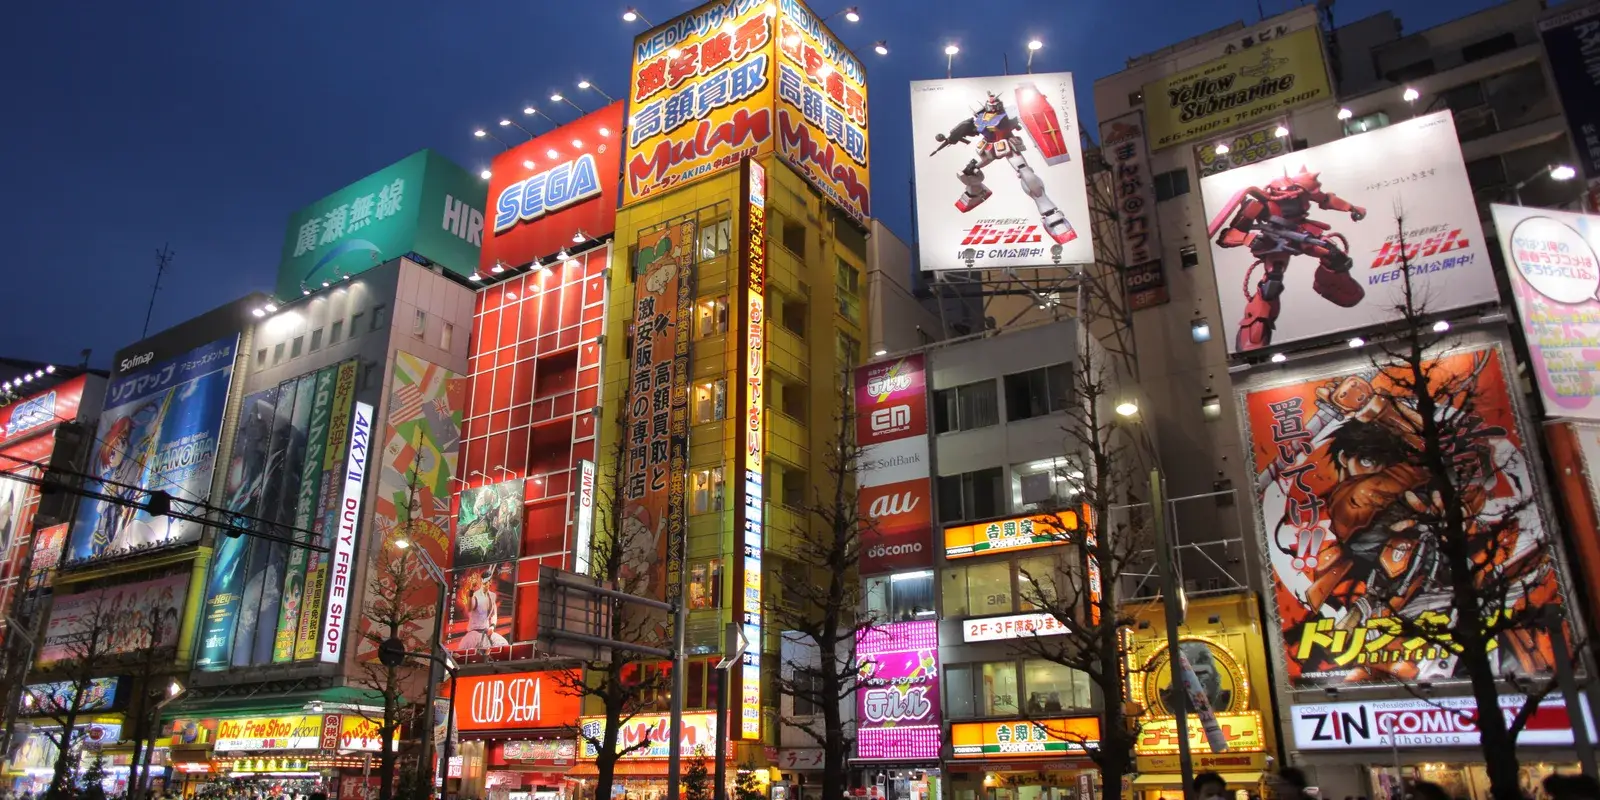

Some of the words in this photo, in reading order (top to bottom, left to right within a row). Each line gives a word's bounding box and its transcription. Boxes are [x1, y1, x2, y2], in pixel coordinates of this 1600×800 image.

[637, 0, 766, 63] MEDIAリサイク
[635, 13, 769, 103] 激安販売
[1203, 63, 1229, 76] BASE
[630, 55, 768, 147] 高額買取
[1168, 72, 1237, 108] Yellow
[1179, 74, 1295, 124] Submarine
[780, 63, 867, 168] 高額買取
[628, 107, 772, 197] Mulan
[777, 109, 870, 218] Mulan
[494, 153, 603, 232] SEGA
[640, 174, 681, 196] ムーラン
[681, 163, 712, 181] AKIBA
[817, 178, 838, 201] AKIBA
[442, 194, 485, 248] HIR
[961, 224, 1042, 246] ガンダム
[957, 247, 985, 260] WB
[1368, 269, 1400, 285] WEB
[120, 352, 154, 372] Sofmap
[112, 362, 176, 400] ソフマップ
[628, 296, 656, 500] 激安販売の専門店
[651, 361, 673, 492] 高額買取と
[871, 404, 911, 431] EM
[352, 411, 369, 471] AKKY
[877, 453, 920, 470] SoftBank
[581, 466, 594, 508] GAME
[1267, 396, 1325, 570] 置いてけ!!
[869, 491, 920, 518] au
[340, 497, 357, 546] DUTY
[986, 518, 1034, 540] 吉野家
[868, 542, 922, 558] docomo
[333, 551, 350, 598] FREE
[987, 594, 1007, 606] 3階
[325, 603, 343, 654] SHOP
[1357, 649, 1450, 664] DRIFTERS
[471, 680, 505, 724] CLUB
[507, 677, 541, 723] SEGA
[866, 689, 929, 720] テルル
[1300, 706, 1329, 714] COMIC
[1416, 699, 1447, 708] Suprt
[220, 721, 243, 739] Duty
[244, 719, 265, 738] Free
[266, 718, 292, 738] Shop
[323, 715, 339, 749] 免税店
[583, 719, 600, 738] 買取
[997, 723, 1047, 741] 吉野家
[1301, 704, 1370, 745] ZIN
[1377, 709, 1477, 732] COMIC
[999, 742, 1046, 753] YOSHINOYA
[1380, 735, 1461, 745] Aihabara
[787, 751, 823, 767] ラーメ
